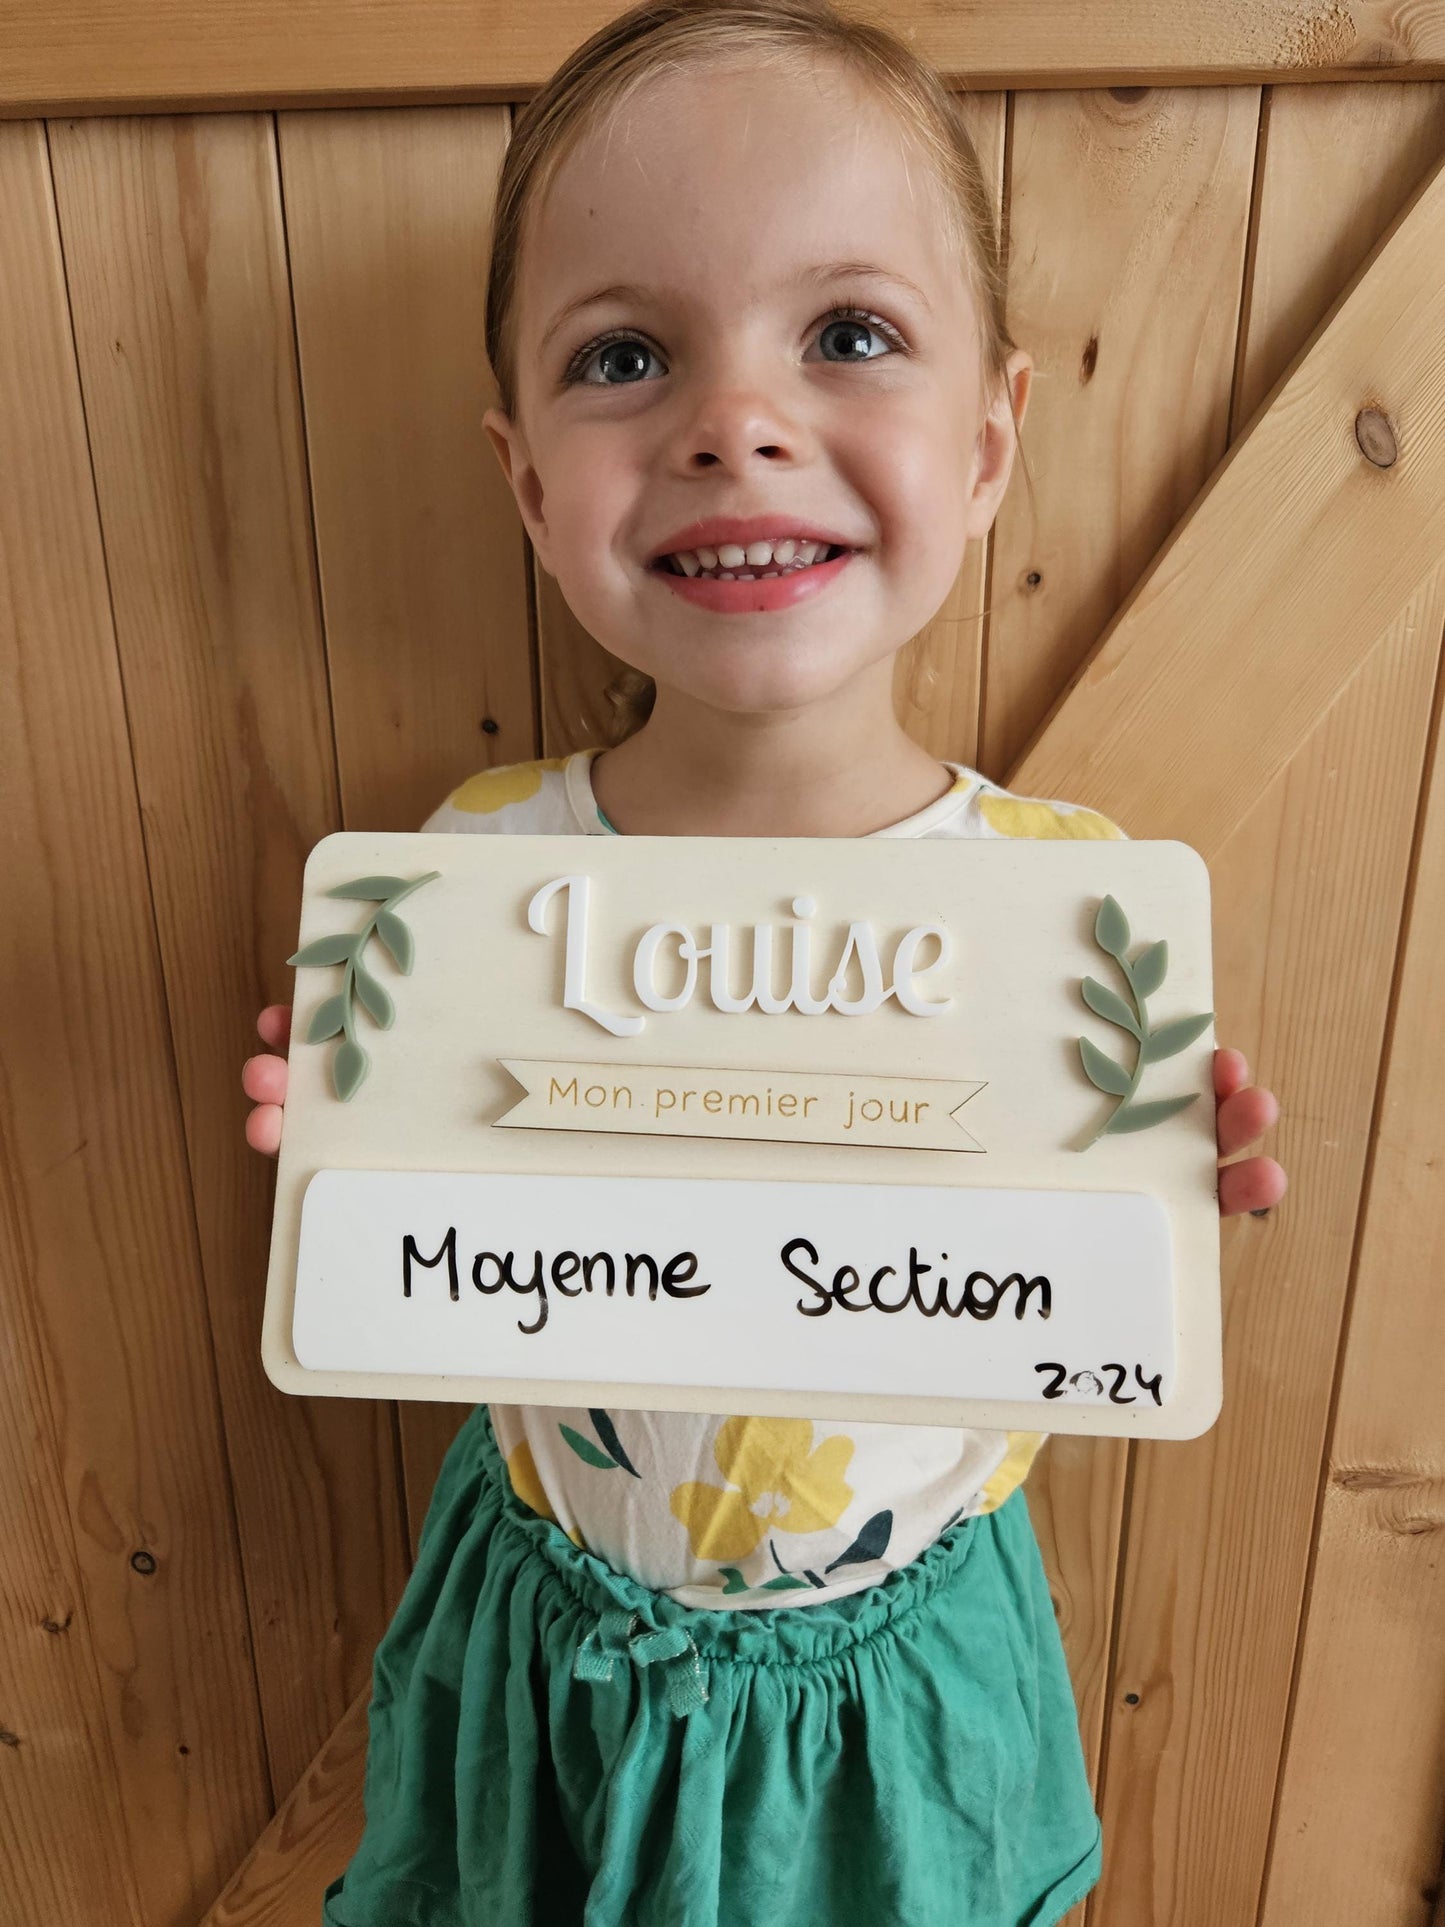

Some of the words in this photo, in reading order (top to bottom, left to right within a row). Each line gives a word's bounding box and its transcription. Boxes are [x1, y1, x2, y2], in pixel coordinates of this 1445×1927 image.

[528, 875, 955, 1038] Louise
[548, 1077, 633, 1109] Mon
[655, 1087, 818, 1118] premier
[843, 1091, 930, 1130] jour
[402, 1226, 712, 1335] Moyenne
[780, 1236, 1053, 1321] Section
[1033, 1361, 1164, 1407] 2024
